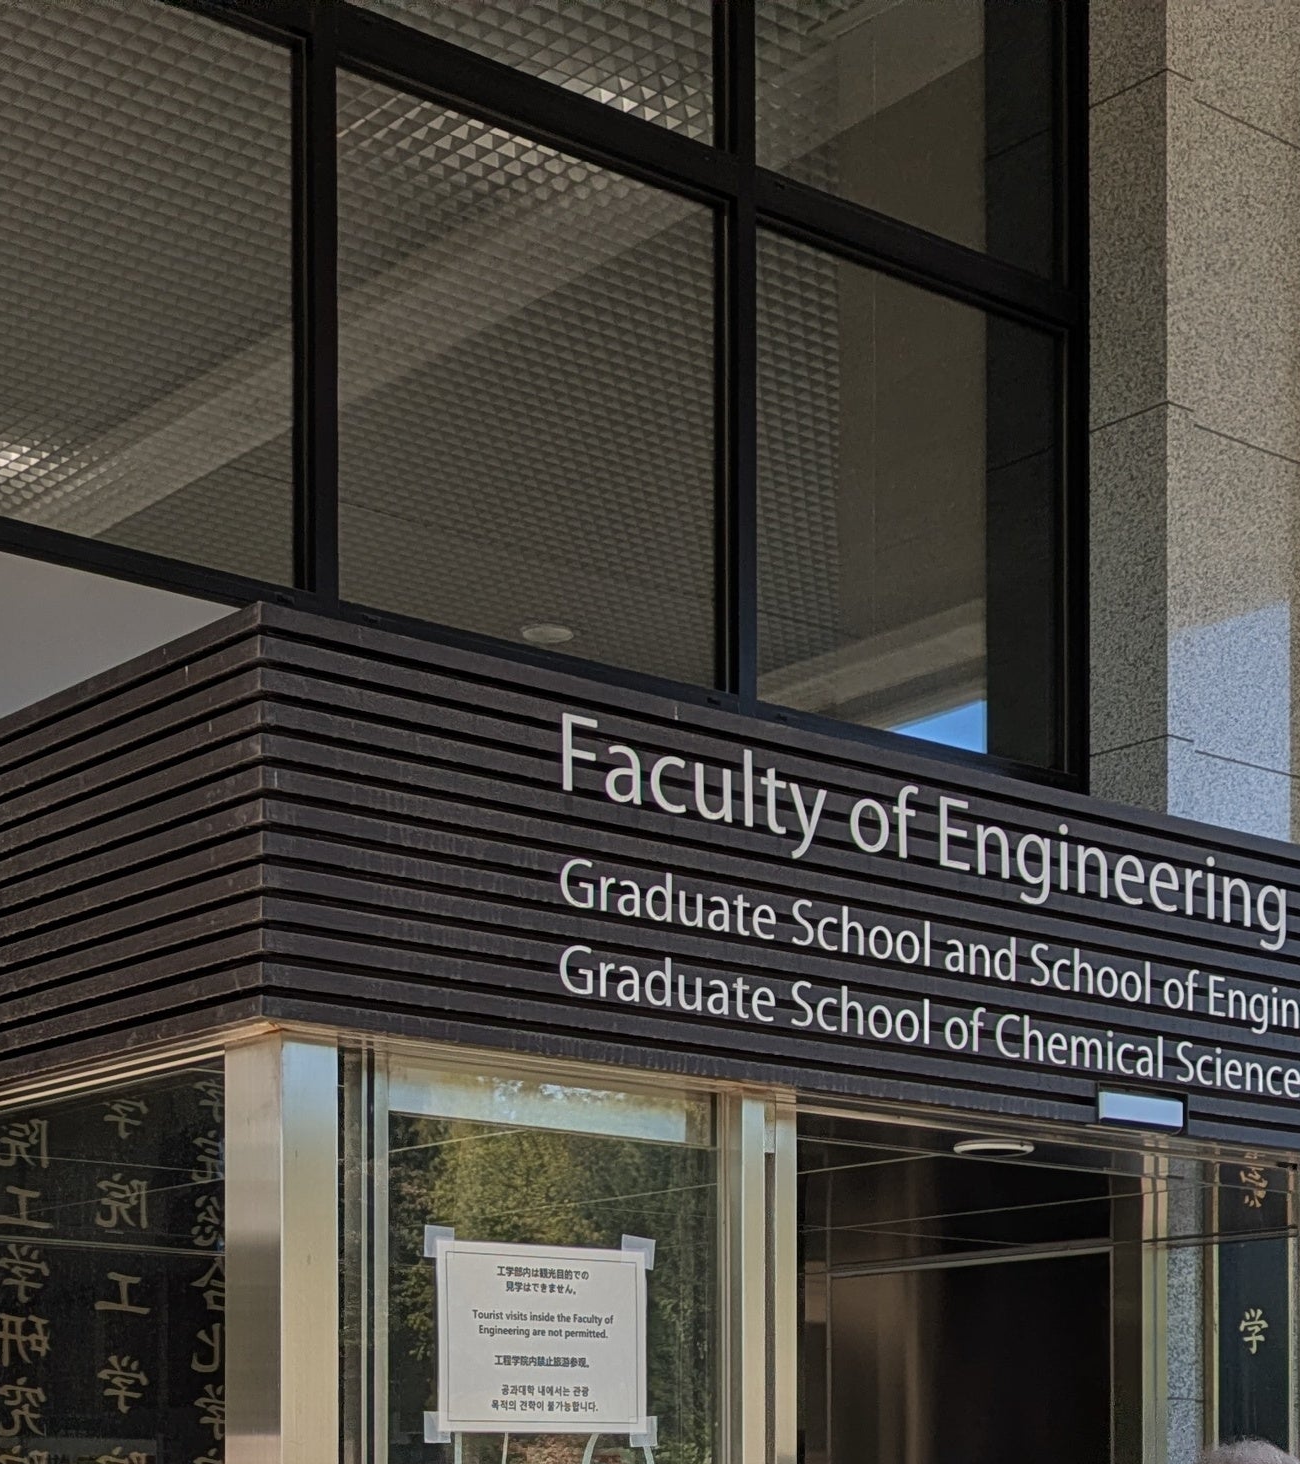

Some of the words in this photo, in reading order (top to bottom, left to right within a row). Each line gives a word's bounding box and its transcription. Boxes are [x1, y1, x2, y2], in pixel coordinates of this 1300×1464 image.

[560, 712, 828, 860] Faculty
[849, 785, 919, 860] of
[938, 795, 1288, 951] Engineering
[559, 857, 777, 940] Graduate
[791, 899, 931, 967] School
[944, 936, 1017, 982] and
[1029, 942, 1152, 1005] School
[1163, 969, 1200, 1013] of
[558, 944, 777, 1024] Graduate
[790, 980, 931, 1046] School
[943, 1007, 987, 1053] of
[995, 1012, 1164, 1080] Chemical
[496, 1265, 590, 1280] 工学部内は観光目的での
[505, 1280, 577, 1295] 見学はできません。
[472, 1309, 504, 1320] Tourist
[505, 1311, 528, 1321] visits
[529, 1311, 555, 1322] inside
[556, 1312, 572, 1323] the
[573, 1313, 603, 1326] Faculty
[604, 1314, 614, 1325] of
[478, 1324, 530, 1338] Engineering
[532, 1328, 546, 1336] are
[548, 1327, 563, 1337] not
[564, 1329, 609, 1339] permitted.
[1238, 1307, 1269, 1355] 学
[501, 1384, 535, 1396] 공과대학
[572, 1386, 589, 1398] 관광
